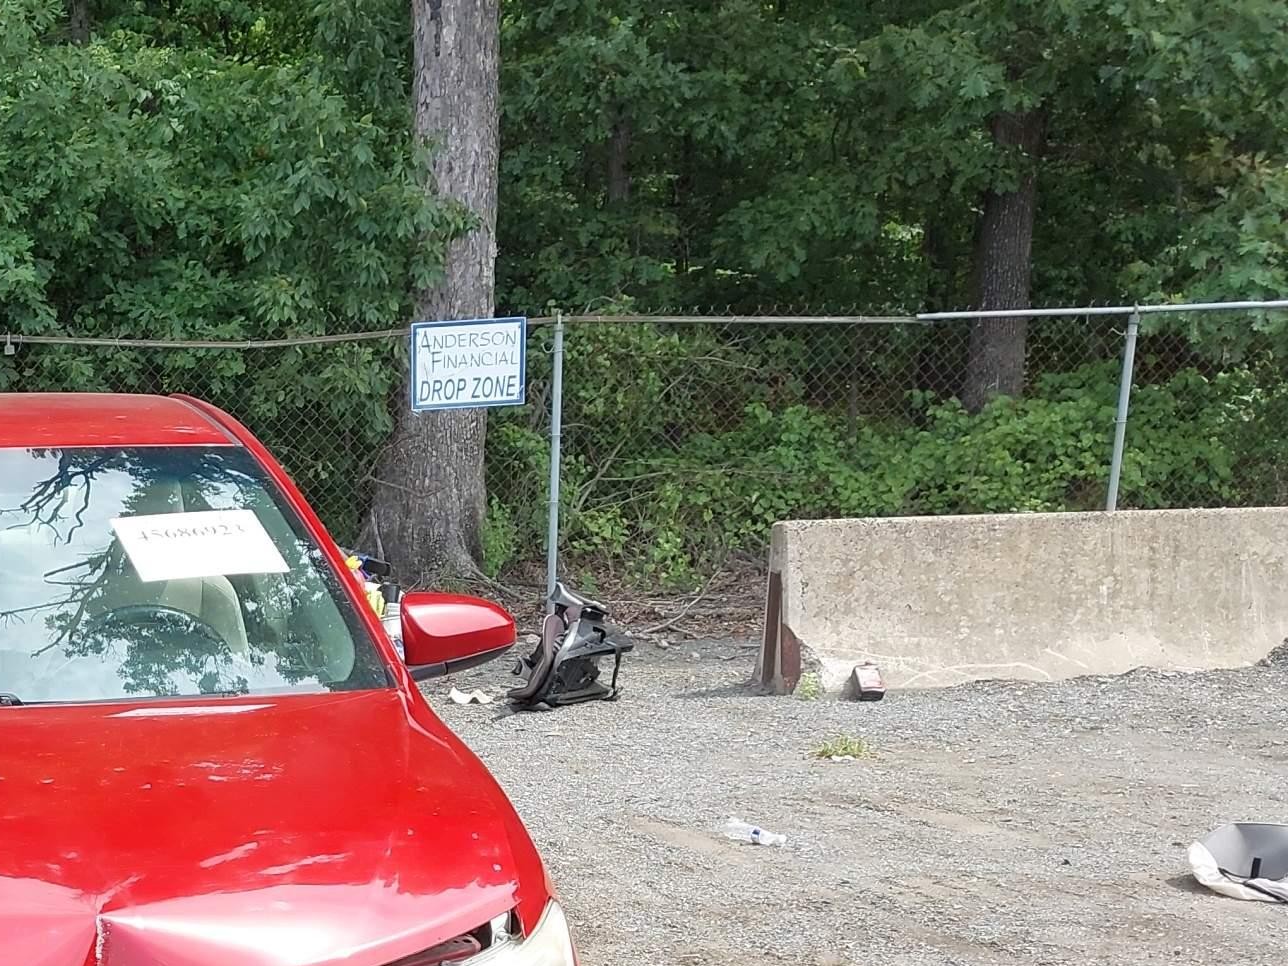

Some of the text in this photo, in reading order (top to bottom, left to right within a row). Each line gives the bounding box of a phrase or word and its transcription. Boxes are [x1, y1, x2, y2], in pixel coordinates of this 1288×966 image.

[420, 330, 517, 353] ANDERSON
[431, 350, 518, 373] FINANCIAL
[419, 375, 518, 402] DROP ZONE
